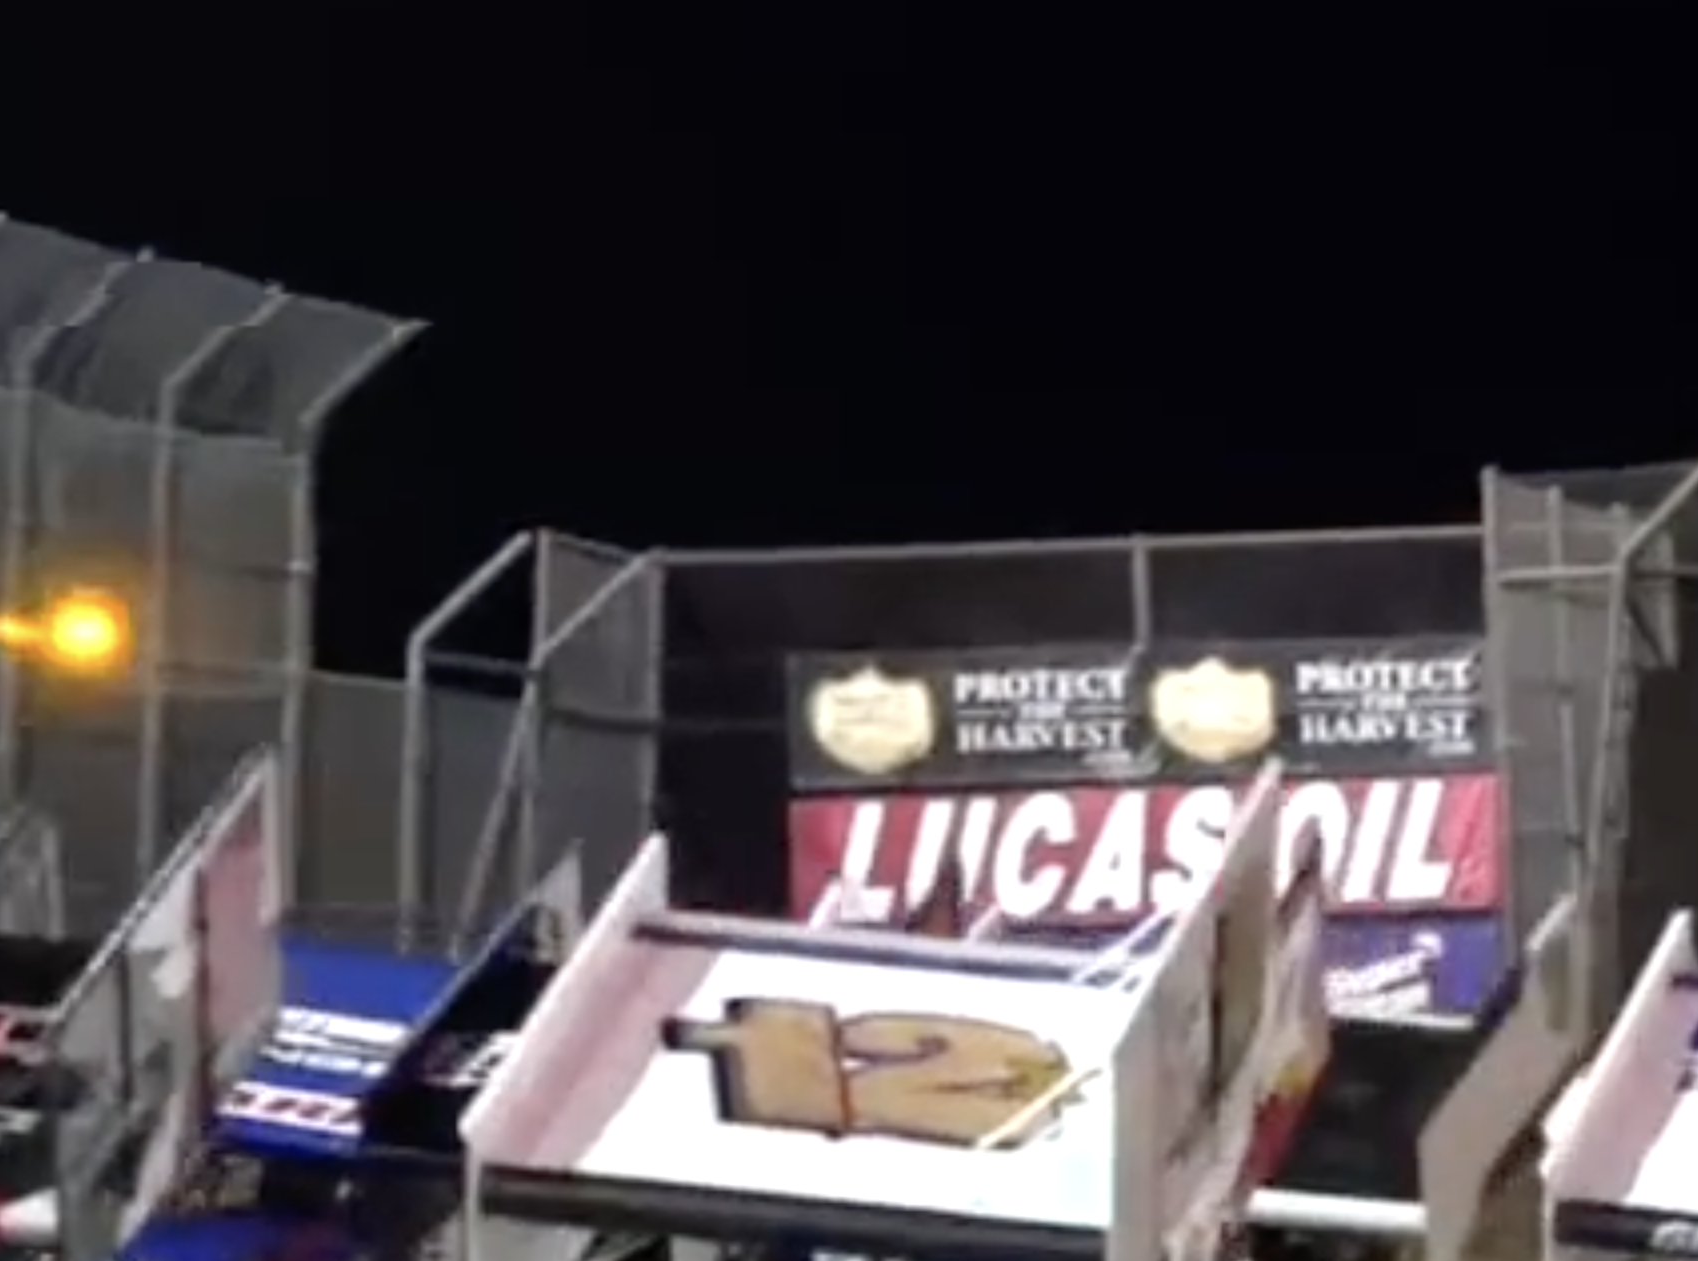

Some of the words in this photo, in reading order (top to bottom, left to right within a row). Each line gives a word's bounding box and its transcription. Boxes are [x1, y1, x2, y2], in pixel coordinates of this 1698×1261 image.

[955, 669, 1128, 701] PROTECT
[1296, 659, 1471, 692] PROTECT
[956, 721, 1127, 753] HARVEST
[1299, 709, 1470, 742] HARVEST
[837, 784, 1232, 926] LUCAS
[1277, 779, 1455, 907] OIL
[661, 995, 1087, 1152] 12
